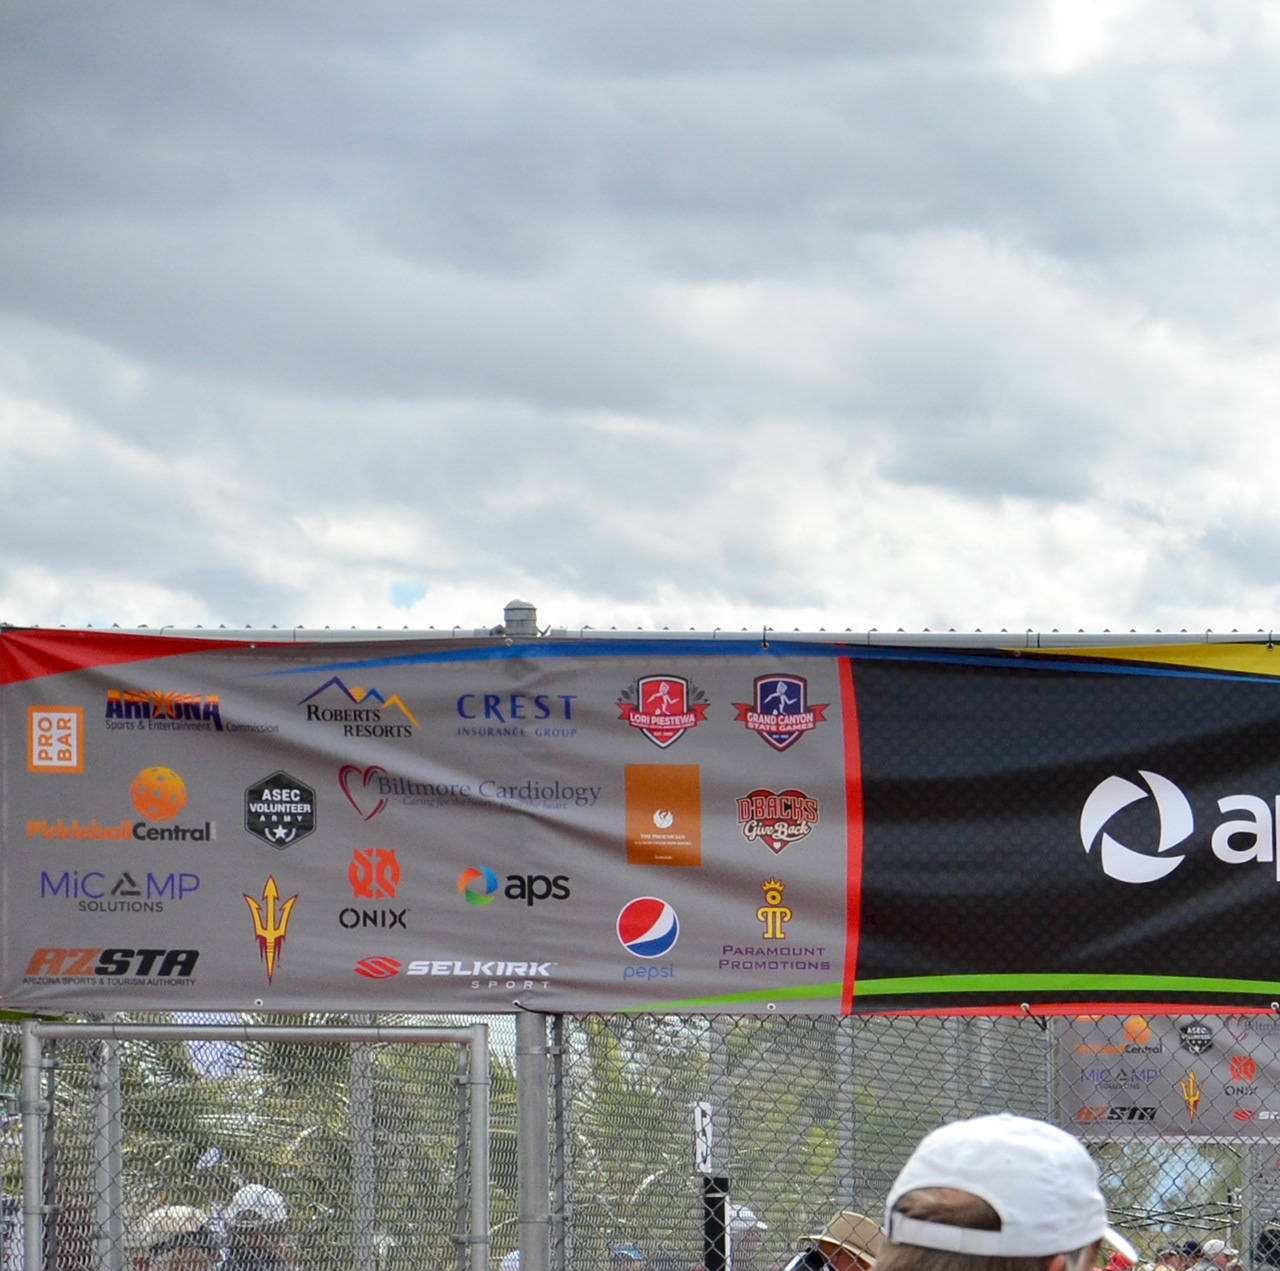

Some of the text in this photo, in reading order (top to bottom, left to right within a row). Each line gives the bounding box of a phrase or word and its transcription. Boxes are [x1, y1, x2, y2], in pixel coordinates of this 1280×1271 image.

[105, 689, 223, 731] ARIZONA
[456, 694, 578, 723] CREST
[629, 712, 650, 724] LORI
[651, 714, 696, 725] PIESTEWA
[746, 712, 813, 725] GRAND CANYON
[105, 720, 279, 733] Sports & Entertainment Commission
[343, 725, 413, 738] RESORTS
[457, 727, 578, 738] INSURANCE GROUP
[747, 722, 814, 731] STATE GAMES
[37, 716, 53, 762] PRO
[57, 717, 72, 762] BAR
[261, 788, 300, 801] ASEC
[378, 777, 471, 797] Biltmore
[478, 779, 602, 807] Cardiology
[249, 803, 311, 813] VOLUNTEER
[743, 821, 809, 842] Give Back
[504, 874, 571, 906] aps
[78, 900, 164, 913] SOLUTIONS
[338, 907, 407, 929] ONIX
[722, 945, 826, 957] PARAMOUNT
[25, 947, 200, 977] AZSTA
[406, 960, 552, 977] SELKIRK
[718, 959, 831, 971] PROMOTIONS
[622, 963, 675, 981] pepsi
[22, 977, 61, 985] ARIZONA
[61, 977, 97, 986] SPORTS
[107, 978, 146, 986] TOURISM
[146, 978, 196, 987] AUTHORITY
[470, 980, 550, 989] SPORT
